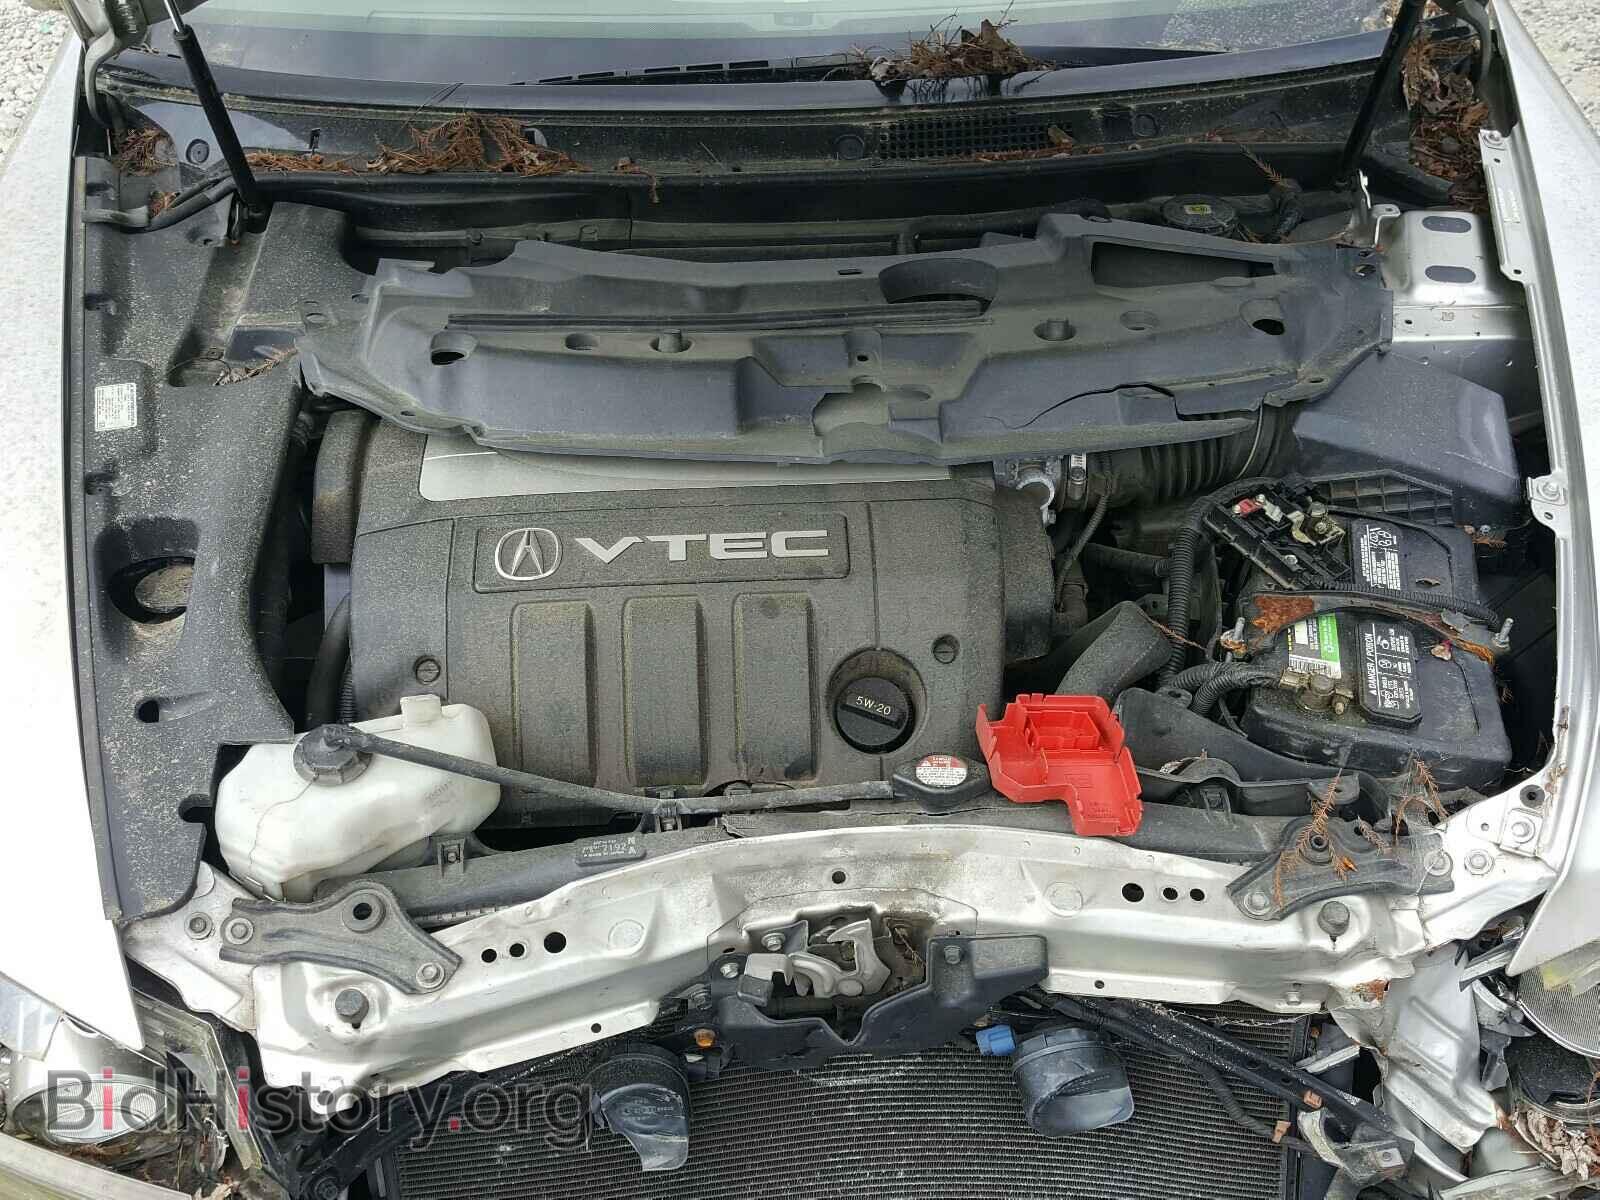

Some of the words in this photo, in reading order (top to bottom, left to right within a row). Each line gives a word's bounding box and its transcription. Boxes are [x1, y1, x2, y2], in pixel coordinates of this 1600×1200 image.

[575, 530, 829, 564] VTEC
[1364, 633, 1374, 656] POISON
[1367, 662, 1376, 689] DANGER
[855, 696, 891, 715] 5W-20
